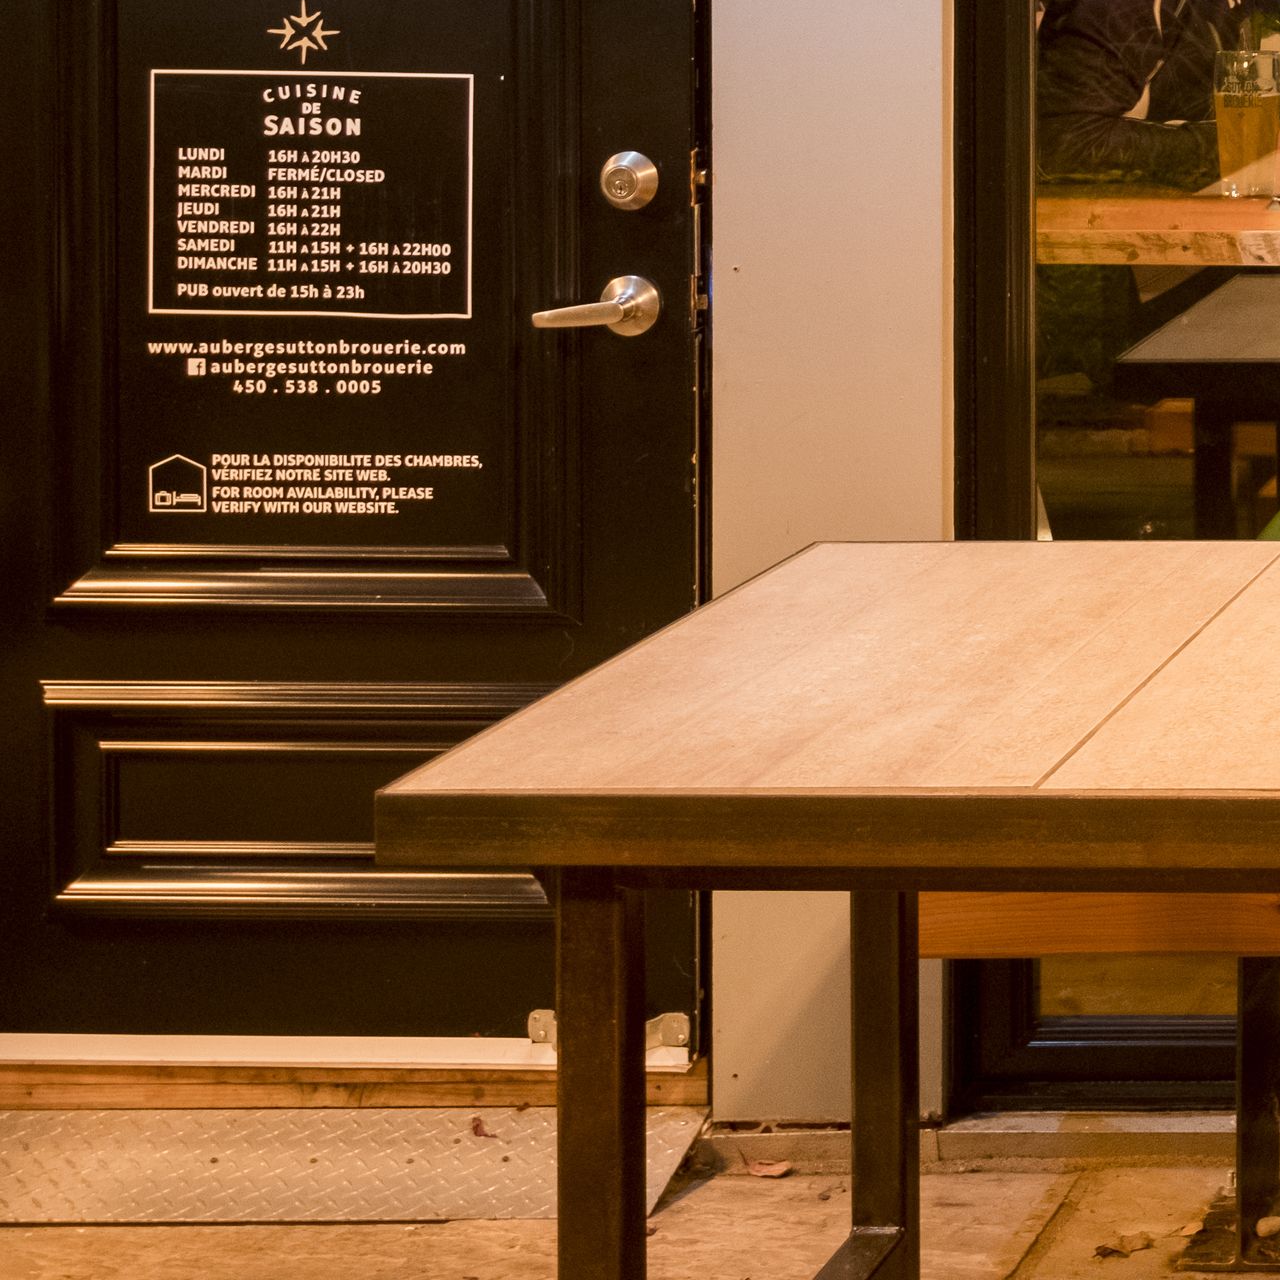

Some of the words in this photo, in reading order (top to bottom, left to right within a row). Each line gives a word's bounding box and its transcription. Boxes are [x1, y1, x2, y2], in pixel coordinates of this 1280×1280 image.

[260, 83, 364, 105] CUISINE
[301, 102, 322, 115] DE
[262, 114, 364, 138] SAISON
[178, 147, 225, 161] LUNDI
[268, 149, 298, 163] 16H
[311, 150, 361, 164] 20H30
[178, 165, 227, 179] MARDI
[268, 164, 386, 183] FERMÉ/CLOSED
[177, 183, 256, 198] MERCREDI
[268, 186, 298, 199] 16H
[311, 186, 341, 200] 21H
[177, 201, 220, 218] JEUDI
[267, 204, 298, 217] 16H
[311, 204, 341, 218] 21H
[176, 220, 255, 234] VENDREDI
[267, 222, 297, 236] 16H
[310, 222, 341, 237] 22H
[177, 238, 235, 252] SAMEDI
[268, 240, 297, 254] 11H
[311, 241, 341, 255] 15H
[359, 242, 389, 256] 16H
[402, 242, 452, 257] 22H00
[177, 256, 258, 271] DIMANCHE
[267, 258, 297, 272] 11H
[311, 259, 341, 273] 15H
[359, 260, 389, 274] 16H
[402, 260, 451, 275] 20H30
[177, 283, 209, 297] PUB
[212, 284, 264, 298] ouvert
[266, 283, 287, 298] de
[290, 284, 319, 299] 15h
[322, 284, 332, 299] à
[336, 284, 365, 299] 23h
[147, 339, 466, 360] www.aubergesuttonbrouerie.com
[210, 358, 433, 378] aubergesuttonbrouerie
[232, 379, 267, 394] 450
[285, 379, 318, 394] 538
[336, 379, 382, 394] 0005
[212, 453, 251, 468] POUR
[252, 454, 271, 467] LA
[374, 454, 402, 467] DES
[404, 454, 483, 469] CHAMBRES,
[323, 469, 354, 482] SITE
[355, 469, 391, 482] WEB.
[212, 486, 241, 499] FOR
[243, 486, 284, 499] ROOM
[286, 486, 380, 501] AVAILABILITY,
[382, 487, 434, 500] PLEASE
[211, 500, 262, 513] VERIFY
[263, 501, 300, 514] WITH
[302, 501, 333, 514] OUR
[334, 501, 400, 514] WEBSITE.
